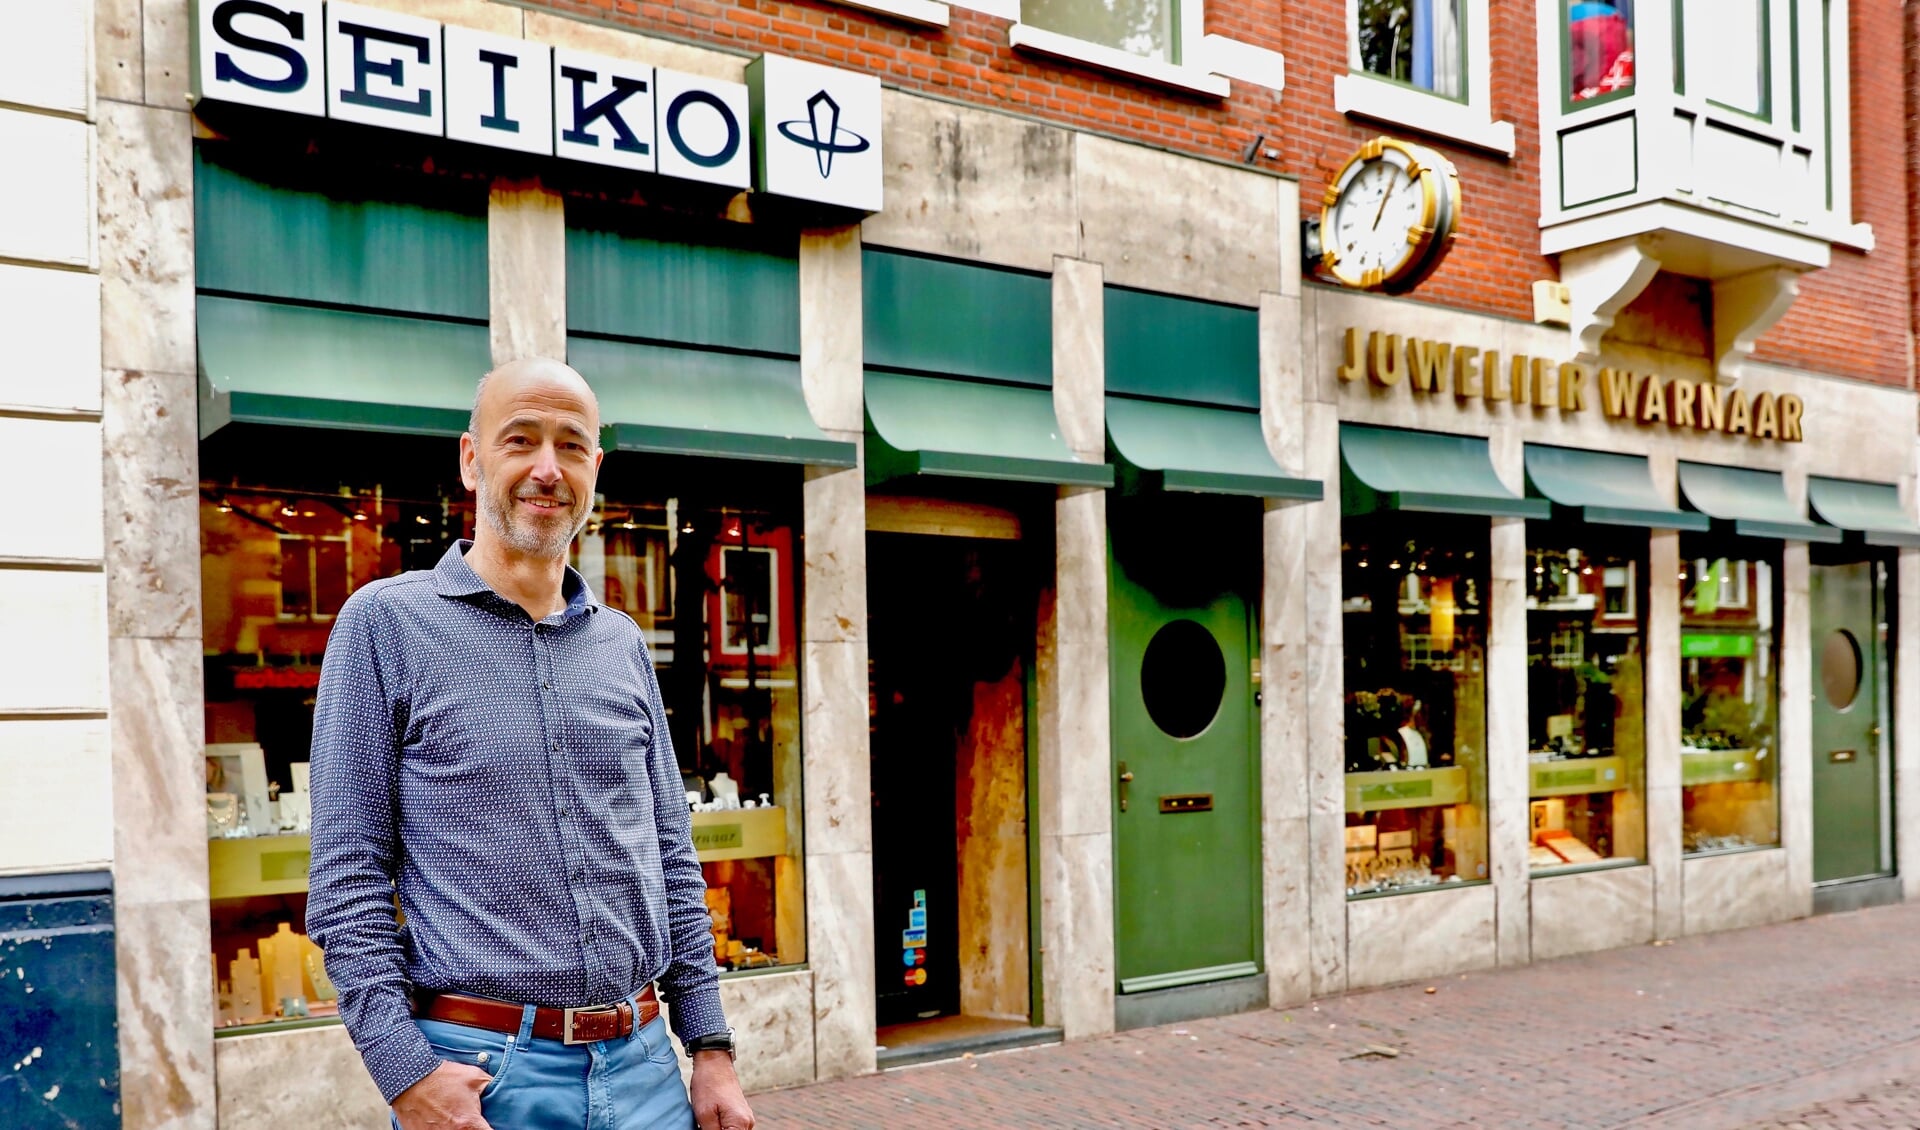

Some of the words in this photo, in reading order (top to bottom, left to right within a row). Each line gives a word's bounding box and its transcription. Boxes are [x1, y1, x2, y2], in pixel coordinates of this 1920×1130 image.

[211, 0, 741, 168] SEIKO
[1337, 327, 1588, 412] JUWELIER
[1600, 367, 1804, 443] WARNAAR
